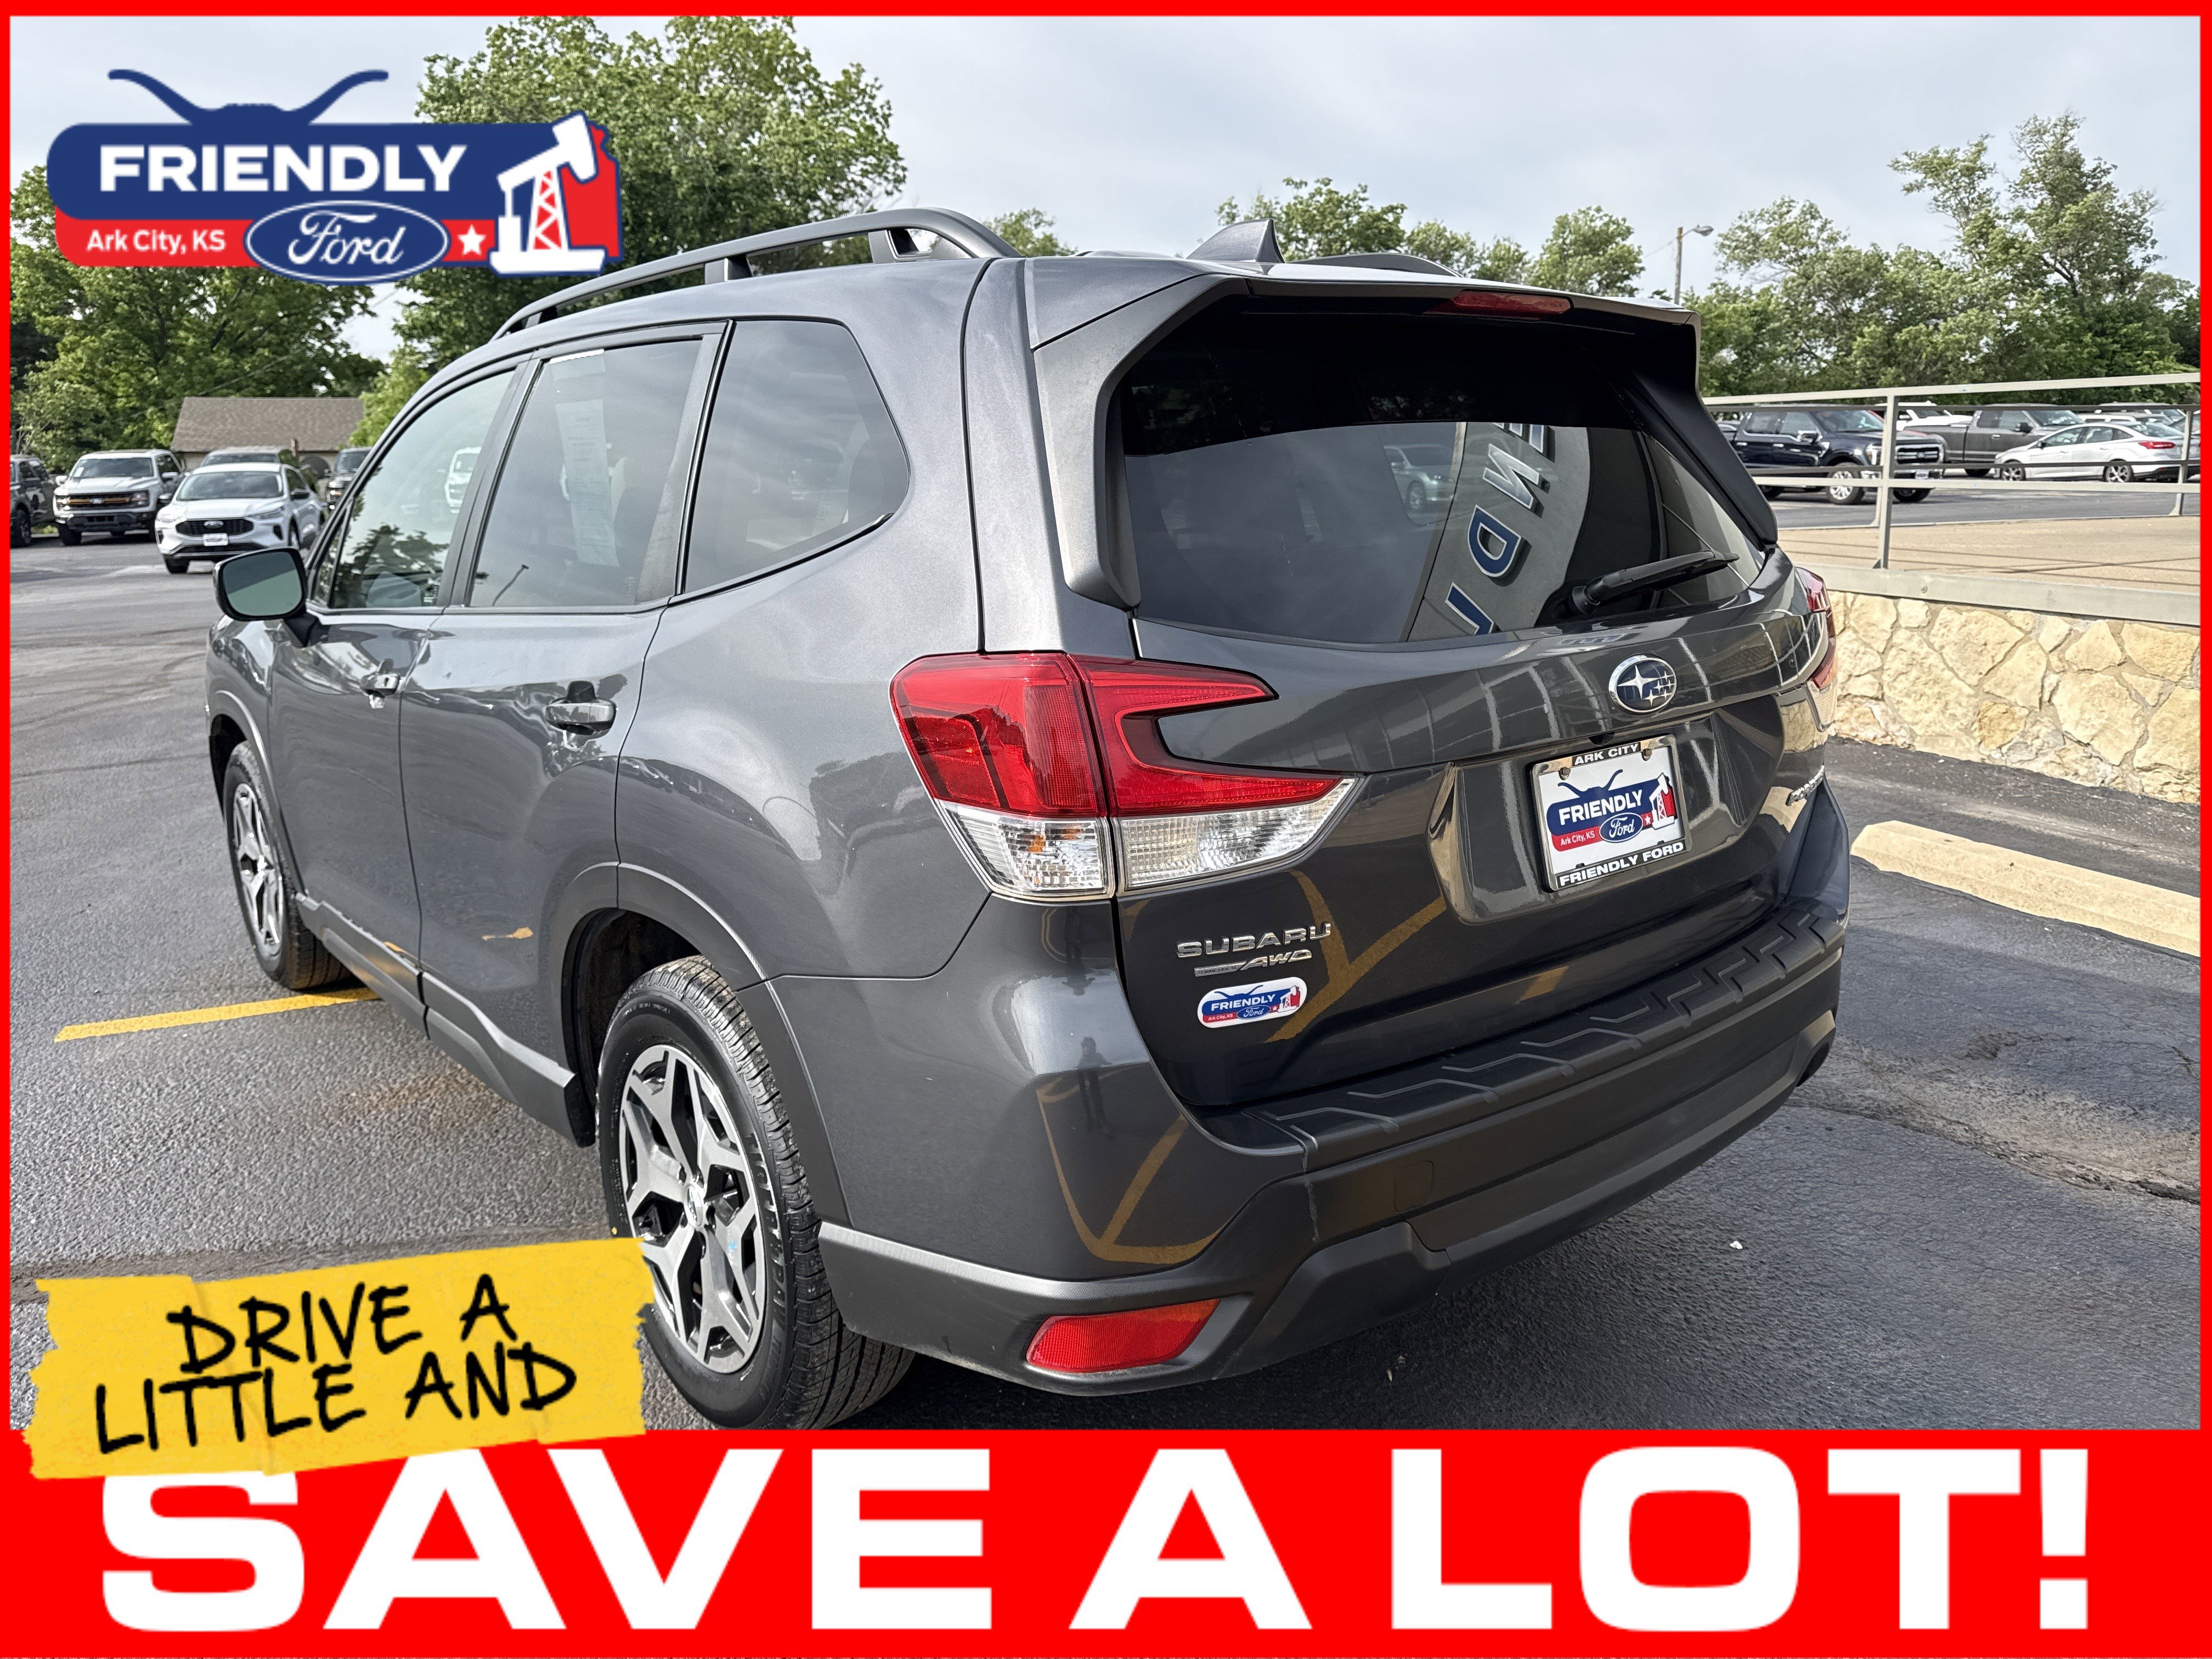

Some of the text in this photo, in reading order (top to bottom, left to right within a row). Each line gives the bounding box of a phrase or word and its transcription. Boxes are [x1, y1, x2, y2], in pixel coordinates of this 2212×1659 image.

[1574, 743, 1640, 765] ARK CITY
[1559, 789, 1643, 826] FRIENDLY
[1609, 816, 1636, 838] Ford
[1560, 830, 1595, 847] Ark City, KS
[1560, 842, 1685, 886] FRIENDLY FORD
[1177, 922, 1331, 958] SUBARU
[1240, 949, 1312, 971] AWD
[1211, 994, 1277, 1012] FRIENDLY
[1243, 1006, 1265, 1018] Ford
